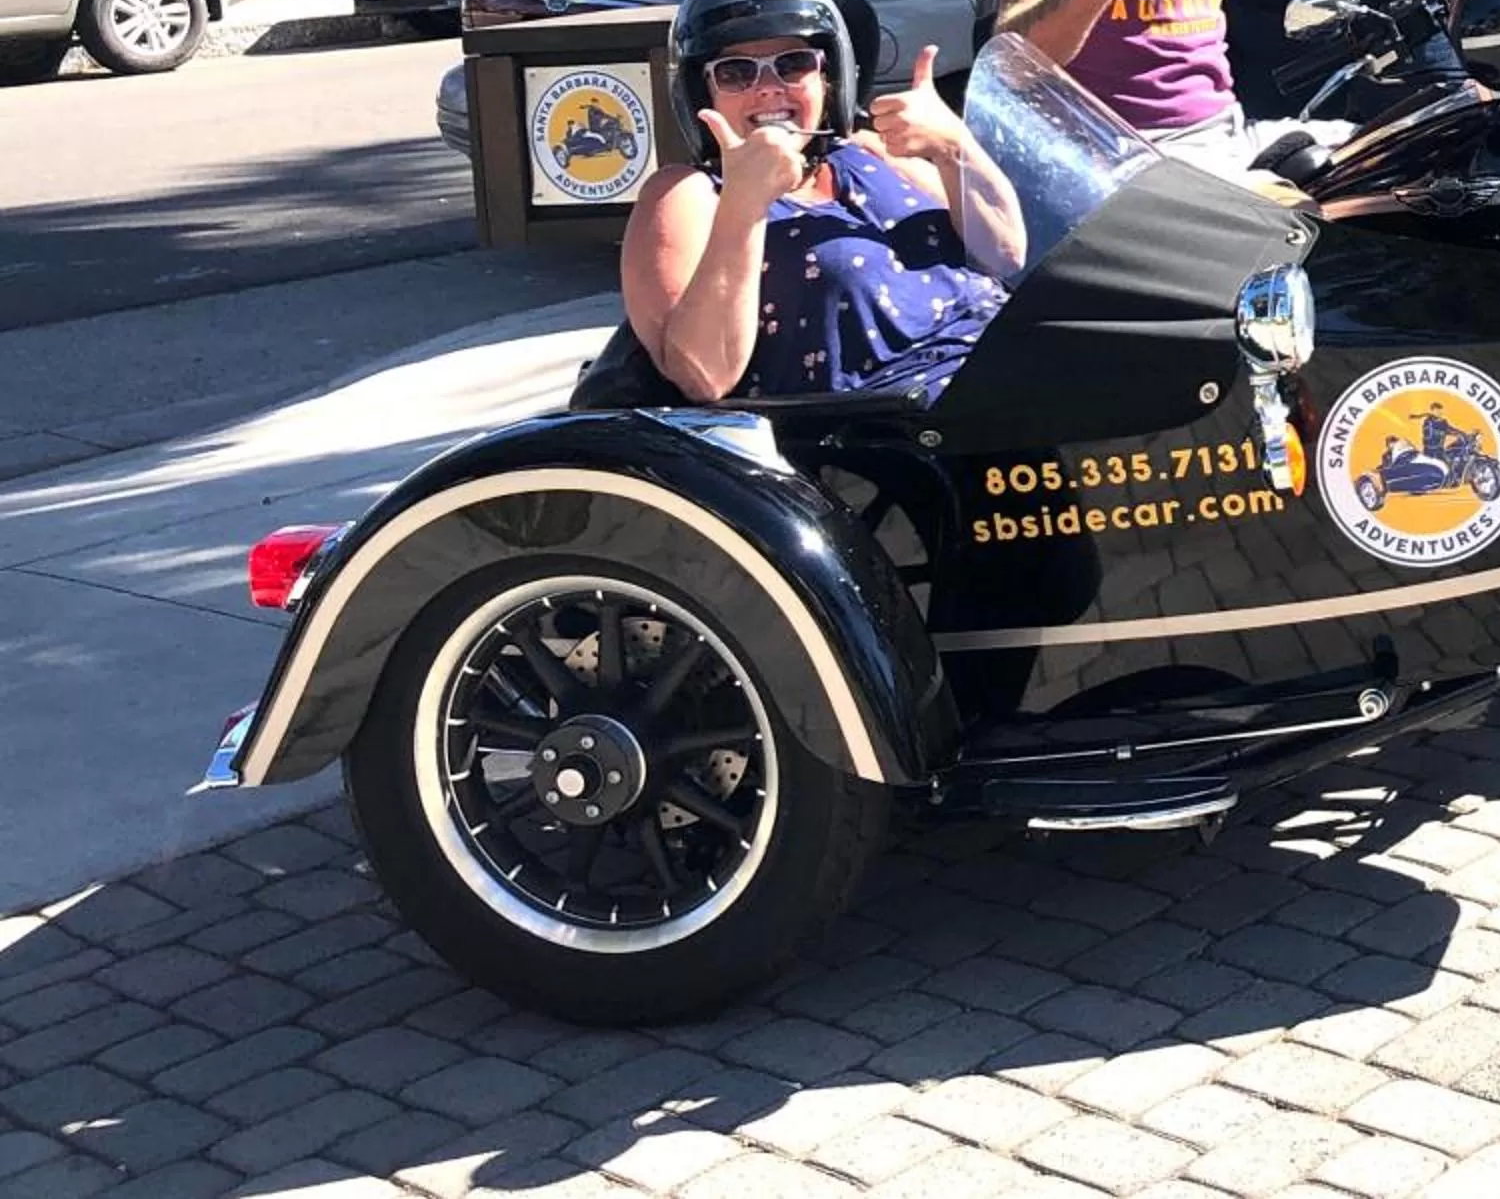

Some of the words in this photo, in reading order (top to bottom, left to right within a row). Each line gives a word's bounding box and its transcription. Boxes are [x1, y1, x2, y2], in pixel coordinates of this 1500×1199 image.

[536, 101, 552, 142] SANTA
[552, 75, 608, 99] BARBARA
[611, 85, 646, 134] SIDECAR
[555, 168, 635, 196] ADVENTURES
[1329, 407, 1363, 469] SANTA
[1362, 369, 1461, 404] BARBARA
[985, 437, 1257, 496] 805.335.7131
[972, 489, 1285, 543] sbsidecar.com
[1355, 514, 1494, 556] ADVENTURES
